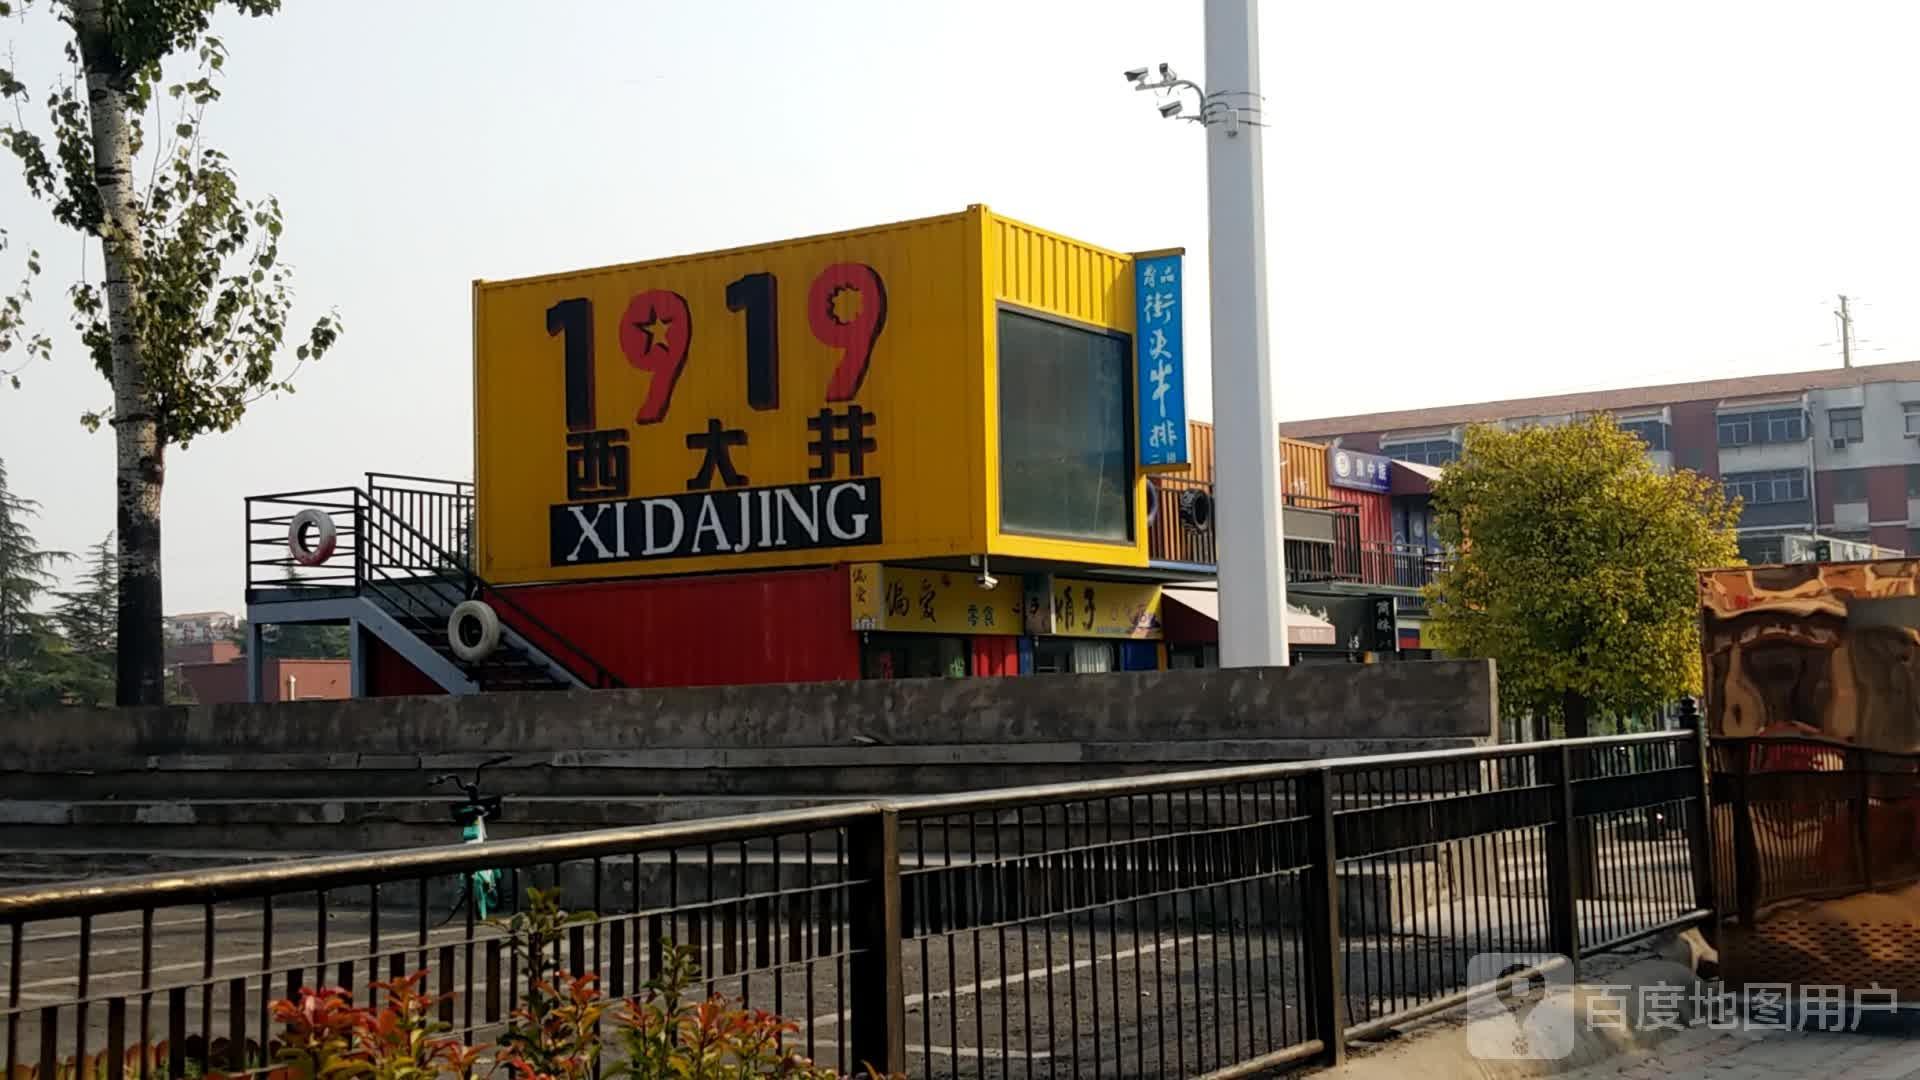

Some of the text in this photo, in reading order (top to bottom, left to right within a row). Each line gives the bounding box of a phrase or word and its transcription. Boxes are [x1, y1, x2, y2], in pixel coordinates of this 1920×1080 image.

[546, 263, 887, 431] 1919
[1144, 293, 1177, 447] 街头牛排
[566, 405, 877, 501] 西大井
[968, 604, 995, 627] 零食
